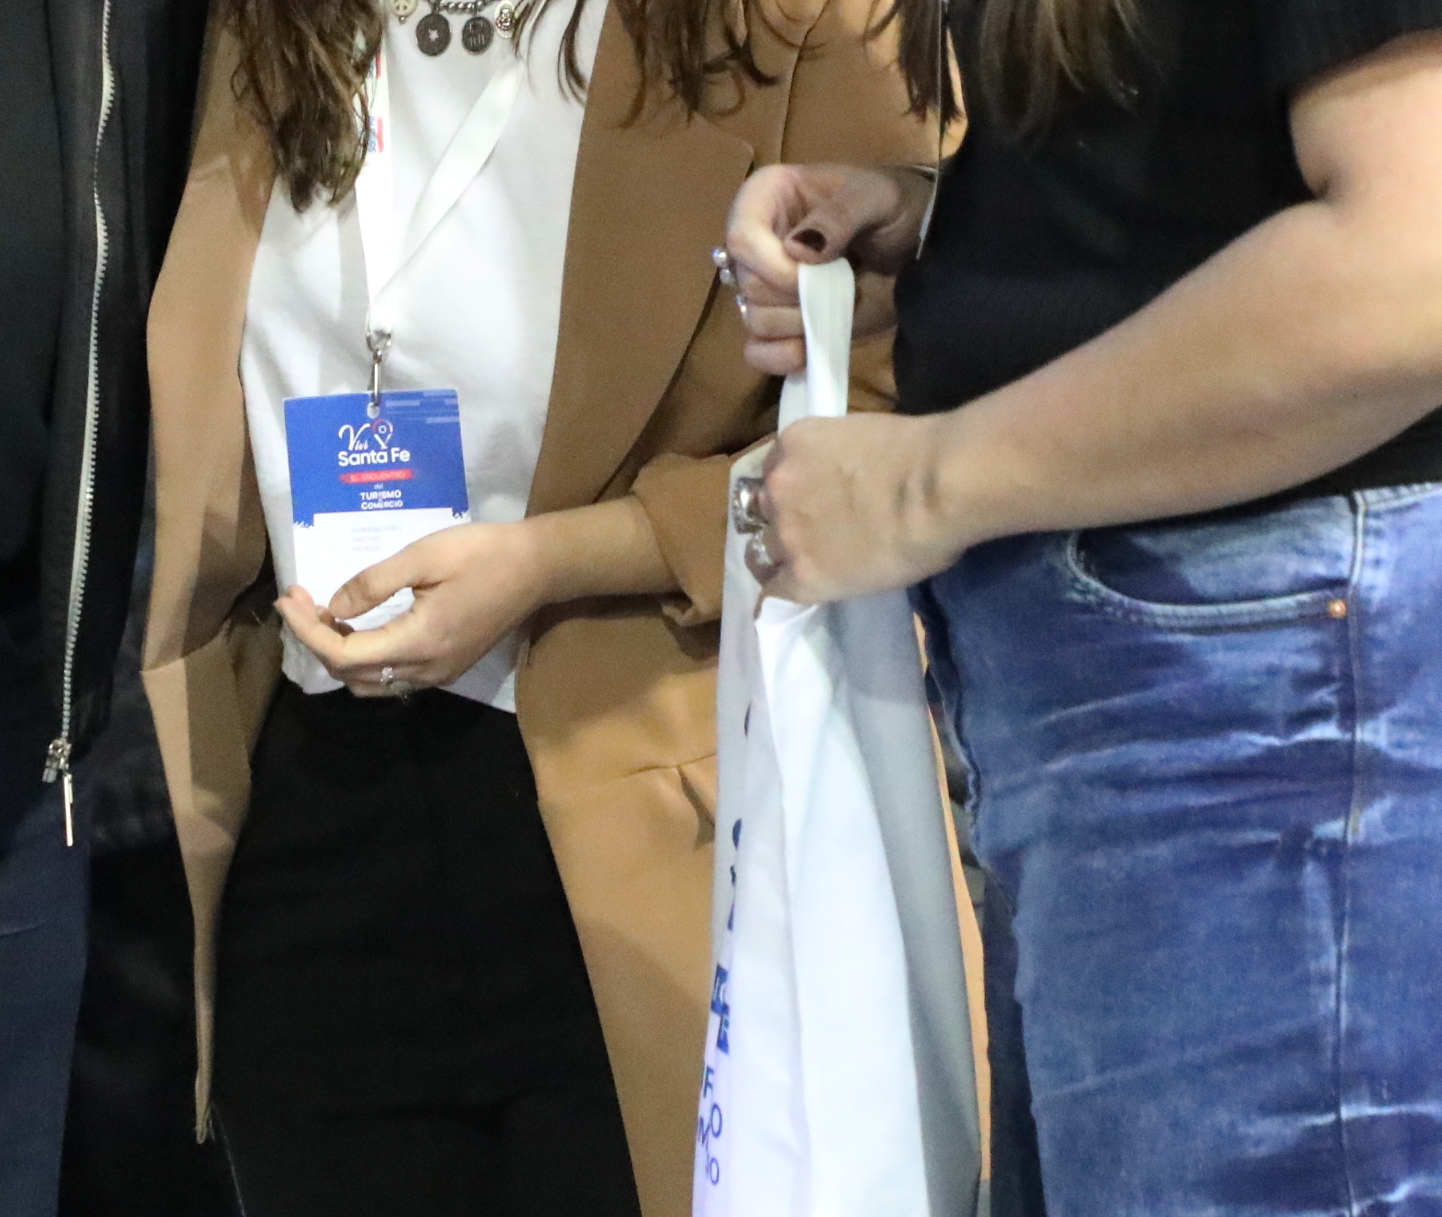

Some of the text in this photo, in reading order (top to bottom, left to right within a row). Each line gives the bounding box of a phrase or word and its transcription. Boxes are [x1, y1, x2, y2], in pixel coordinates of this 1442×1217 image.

[338, 447, 411, 467] Santa Fe
[359, 489, 402, 500] TURISMO
[361, 500, 404, 510] COMERCIO
